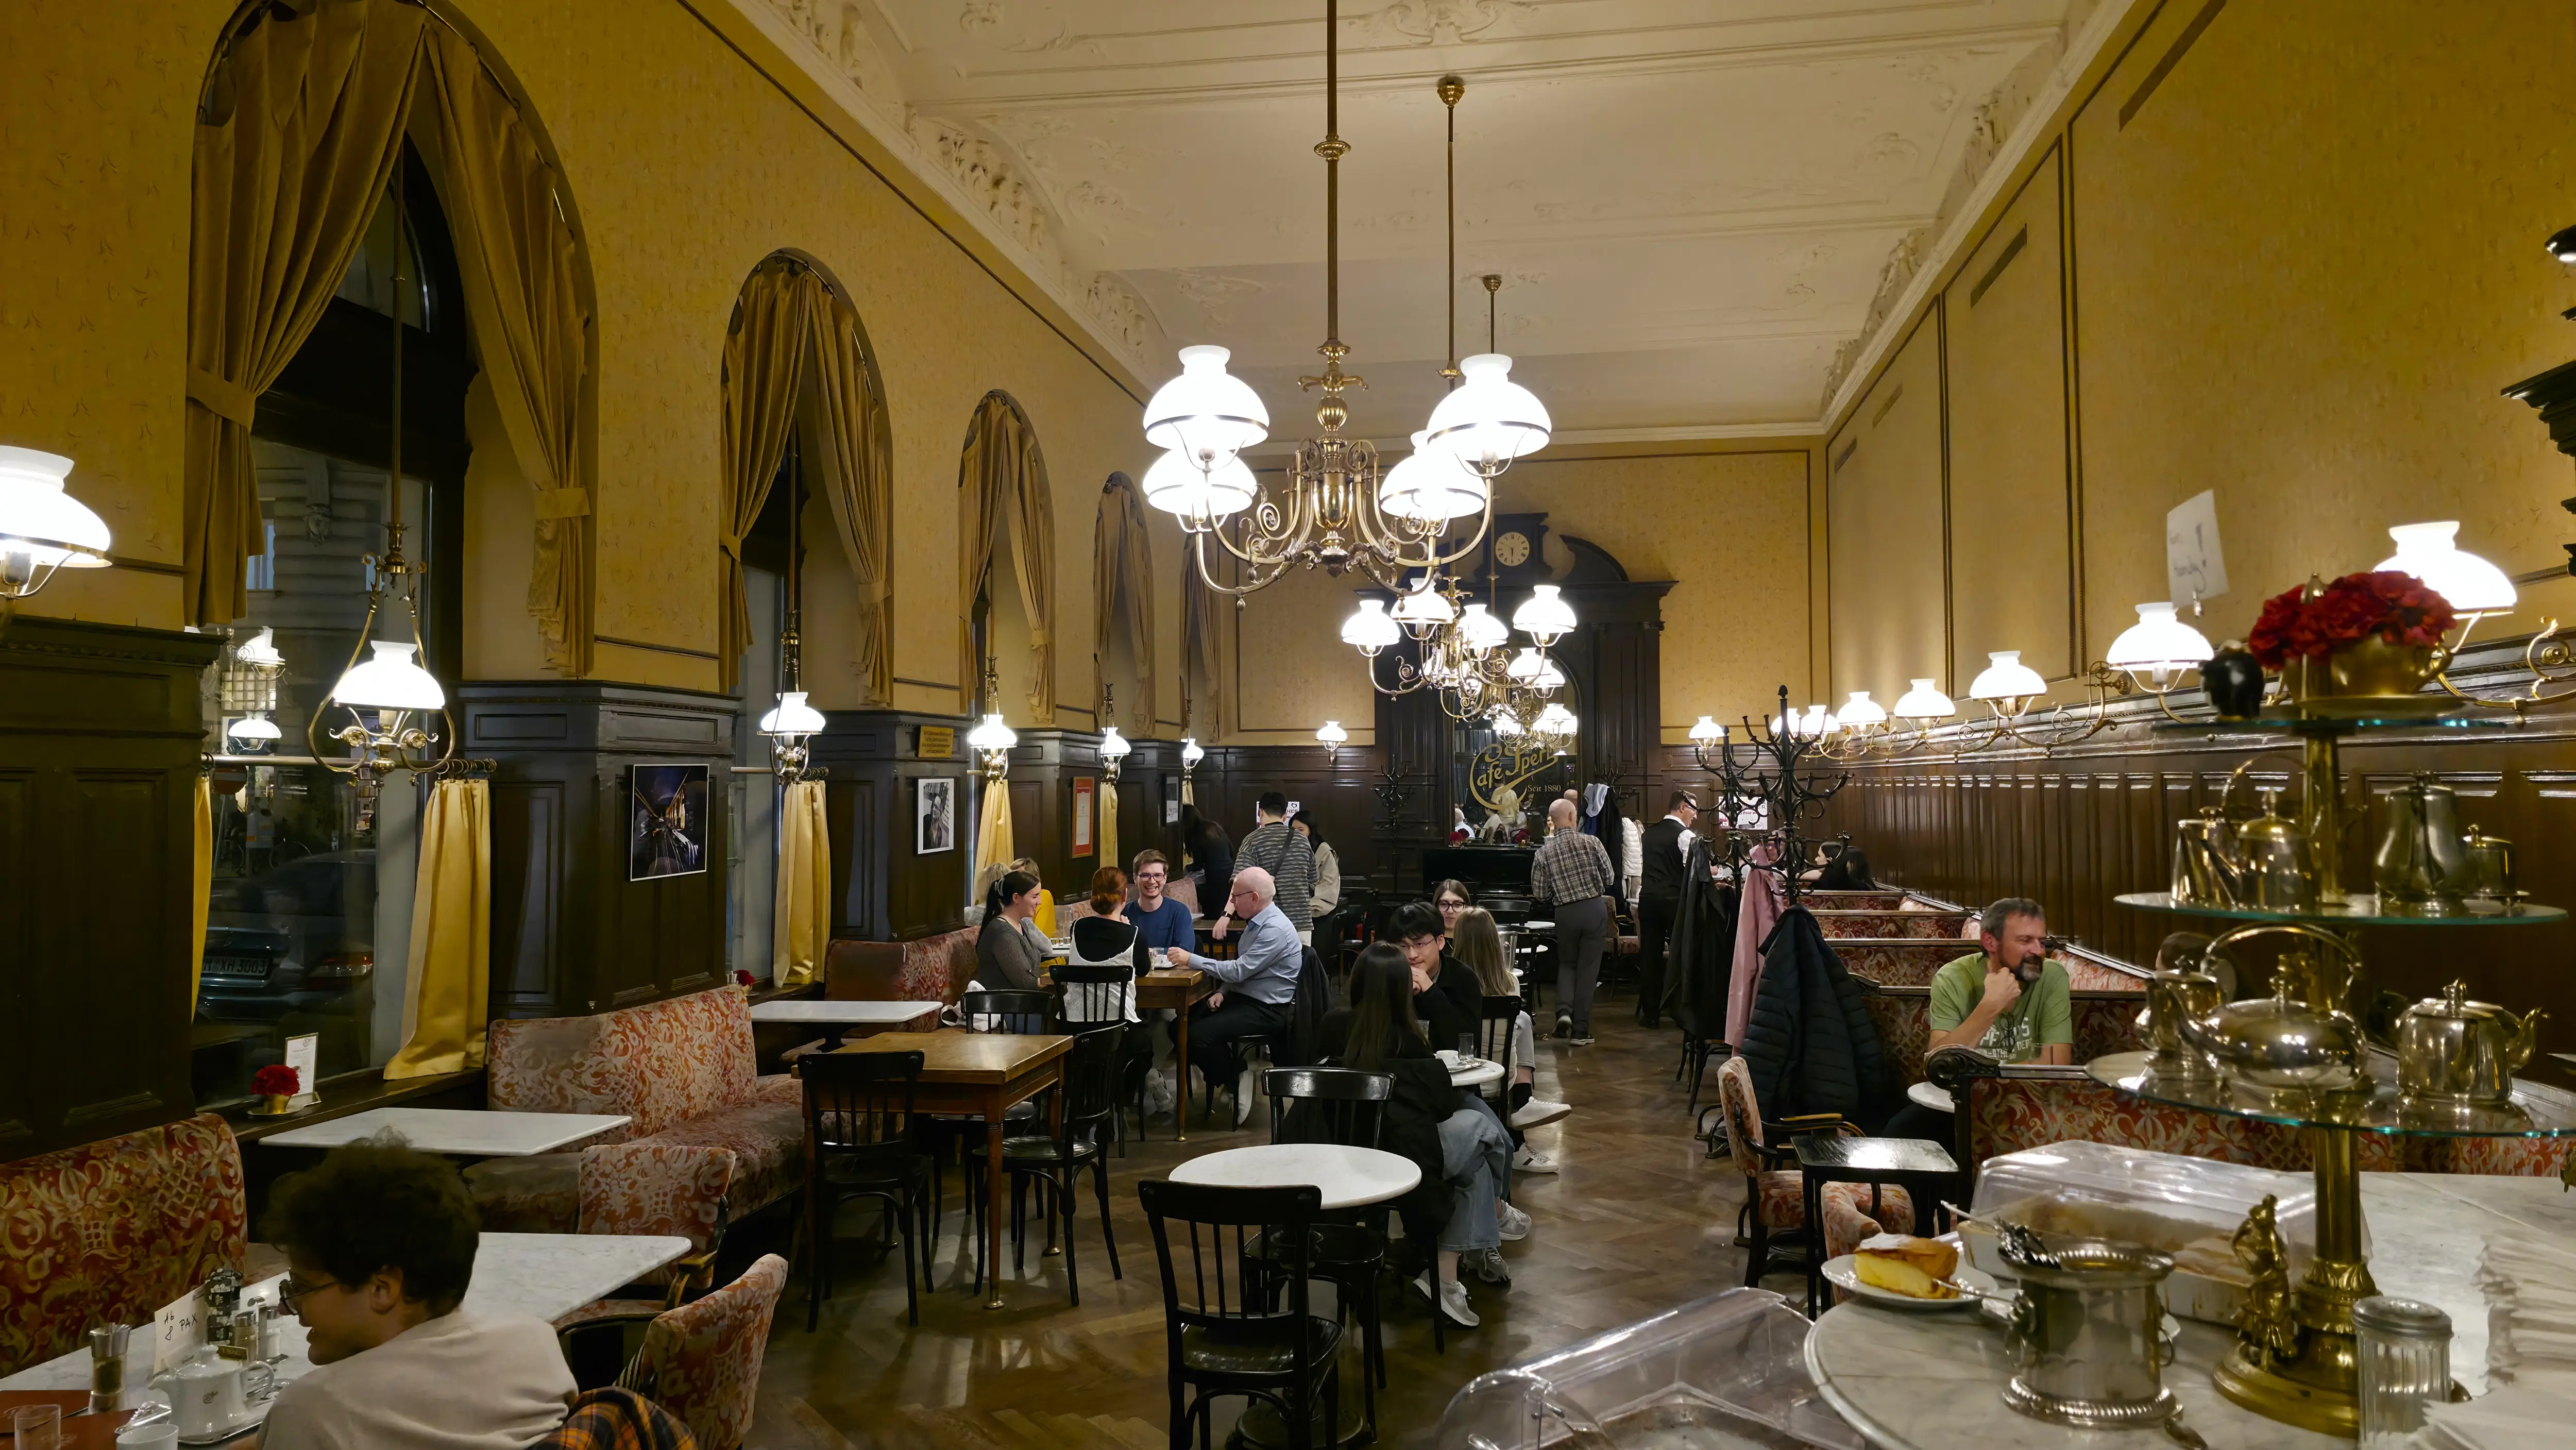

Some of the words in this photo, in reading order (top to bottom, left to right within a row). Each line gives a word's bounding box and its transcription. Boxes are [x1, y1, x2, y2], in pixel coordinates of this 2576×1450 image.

[1470, 744, 1504, 810] Café
[237, 958, 266, 974] 3003
[179, 1314, 198, 1331] PAX
